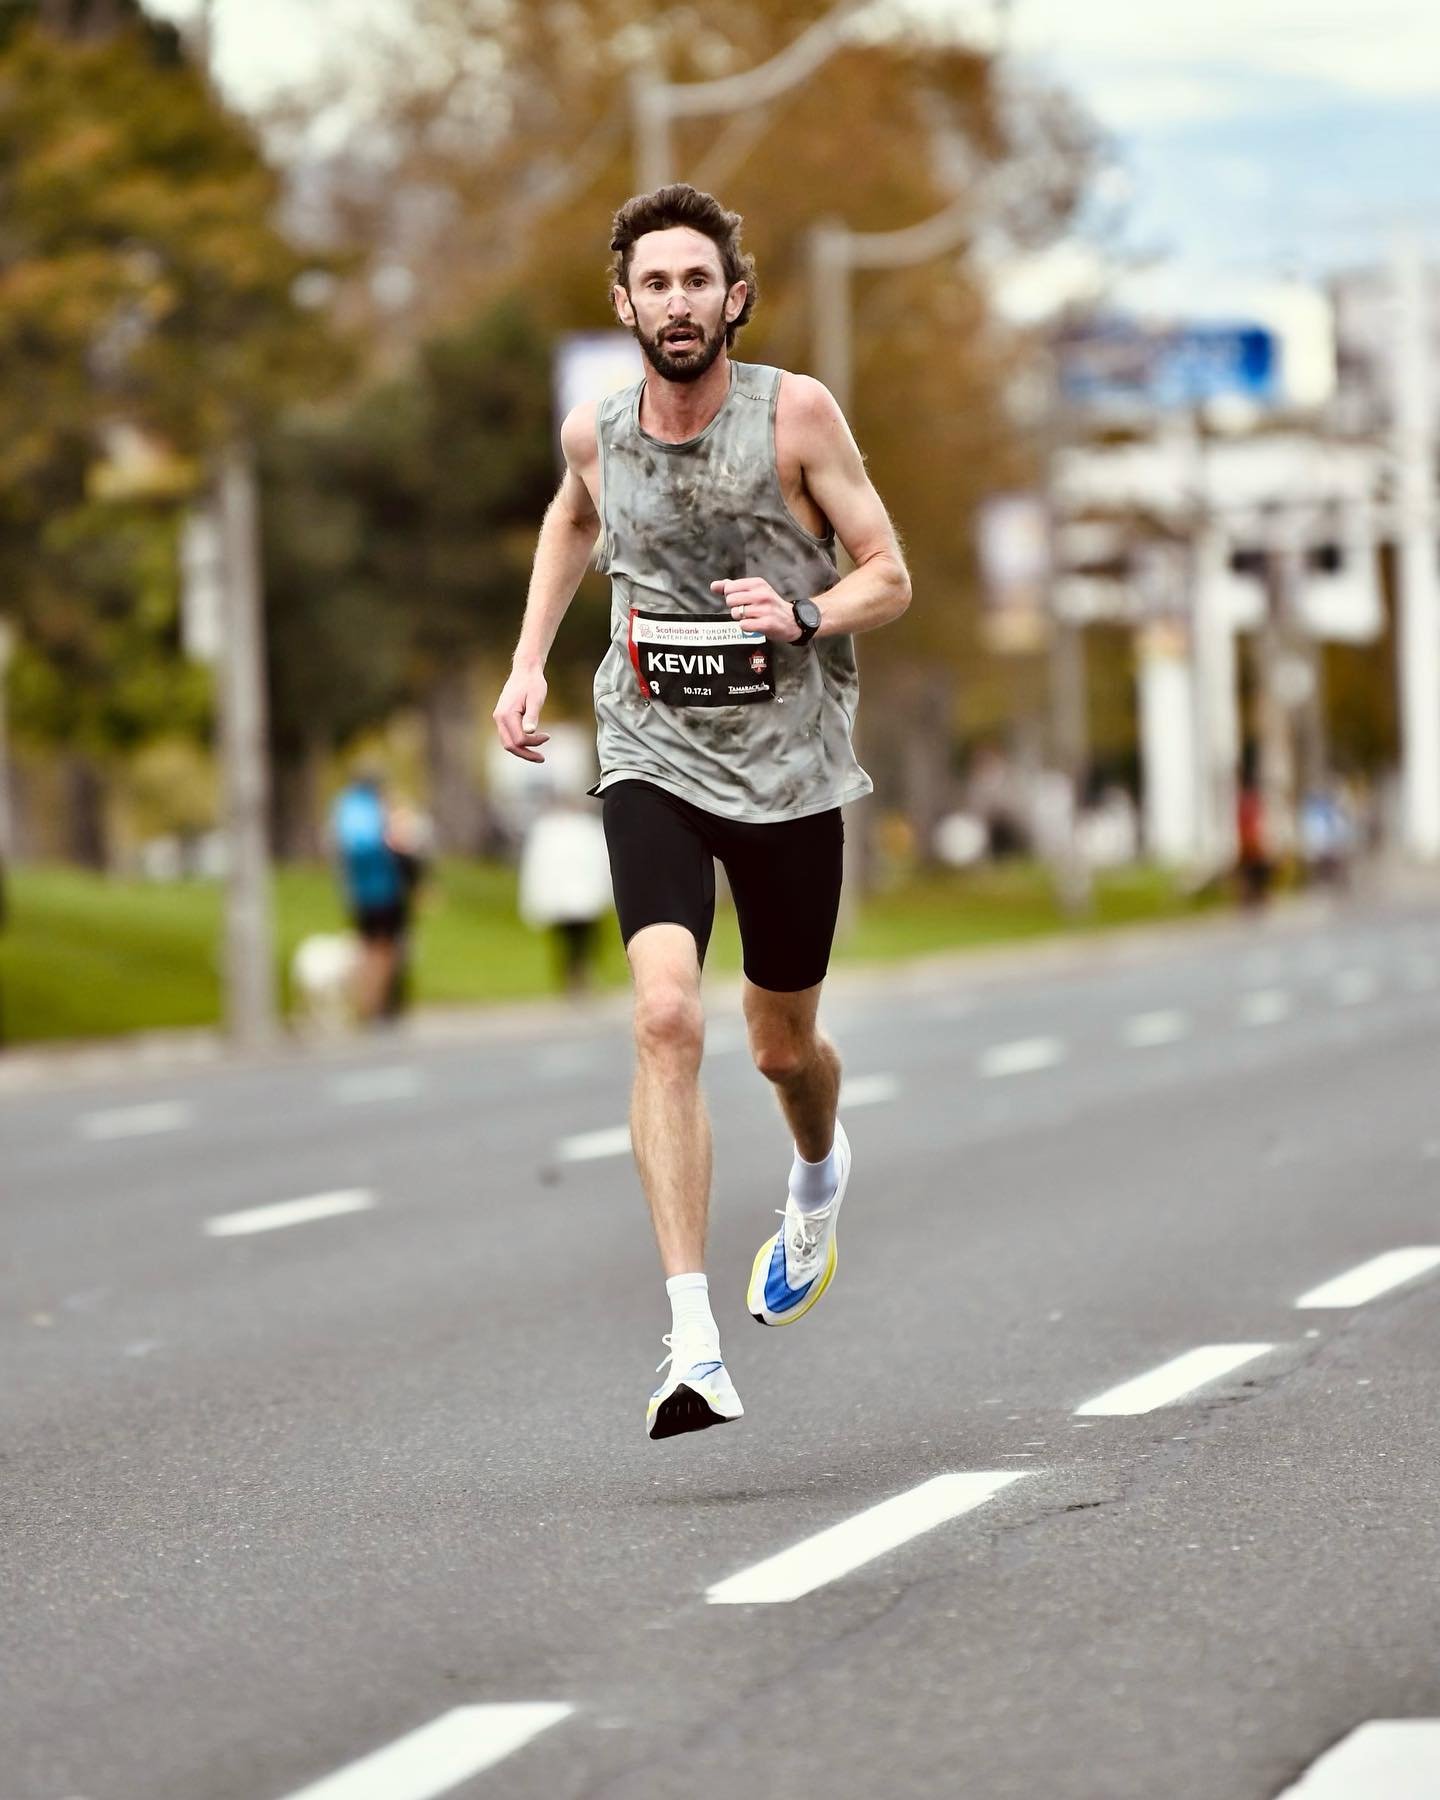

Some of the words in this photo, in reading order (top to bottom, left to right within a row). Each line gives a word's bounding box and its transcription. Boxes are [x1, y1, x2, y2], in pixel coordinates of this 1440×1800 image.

[655, 626, 699, 635] Scotiabank
[647, 651, 725, 675] KEVIN
[683, 686, 712, 696] 10.17.21
